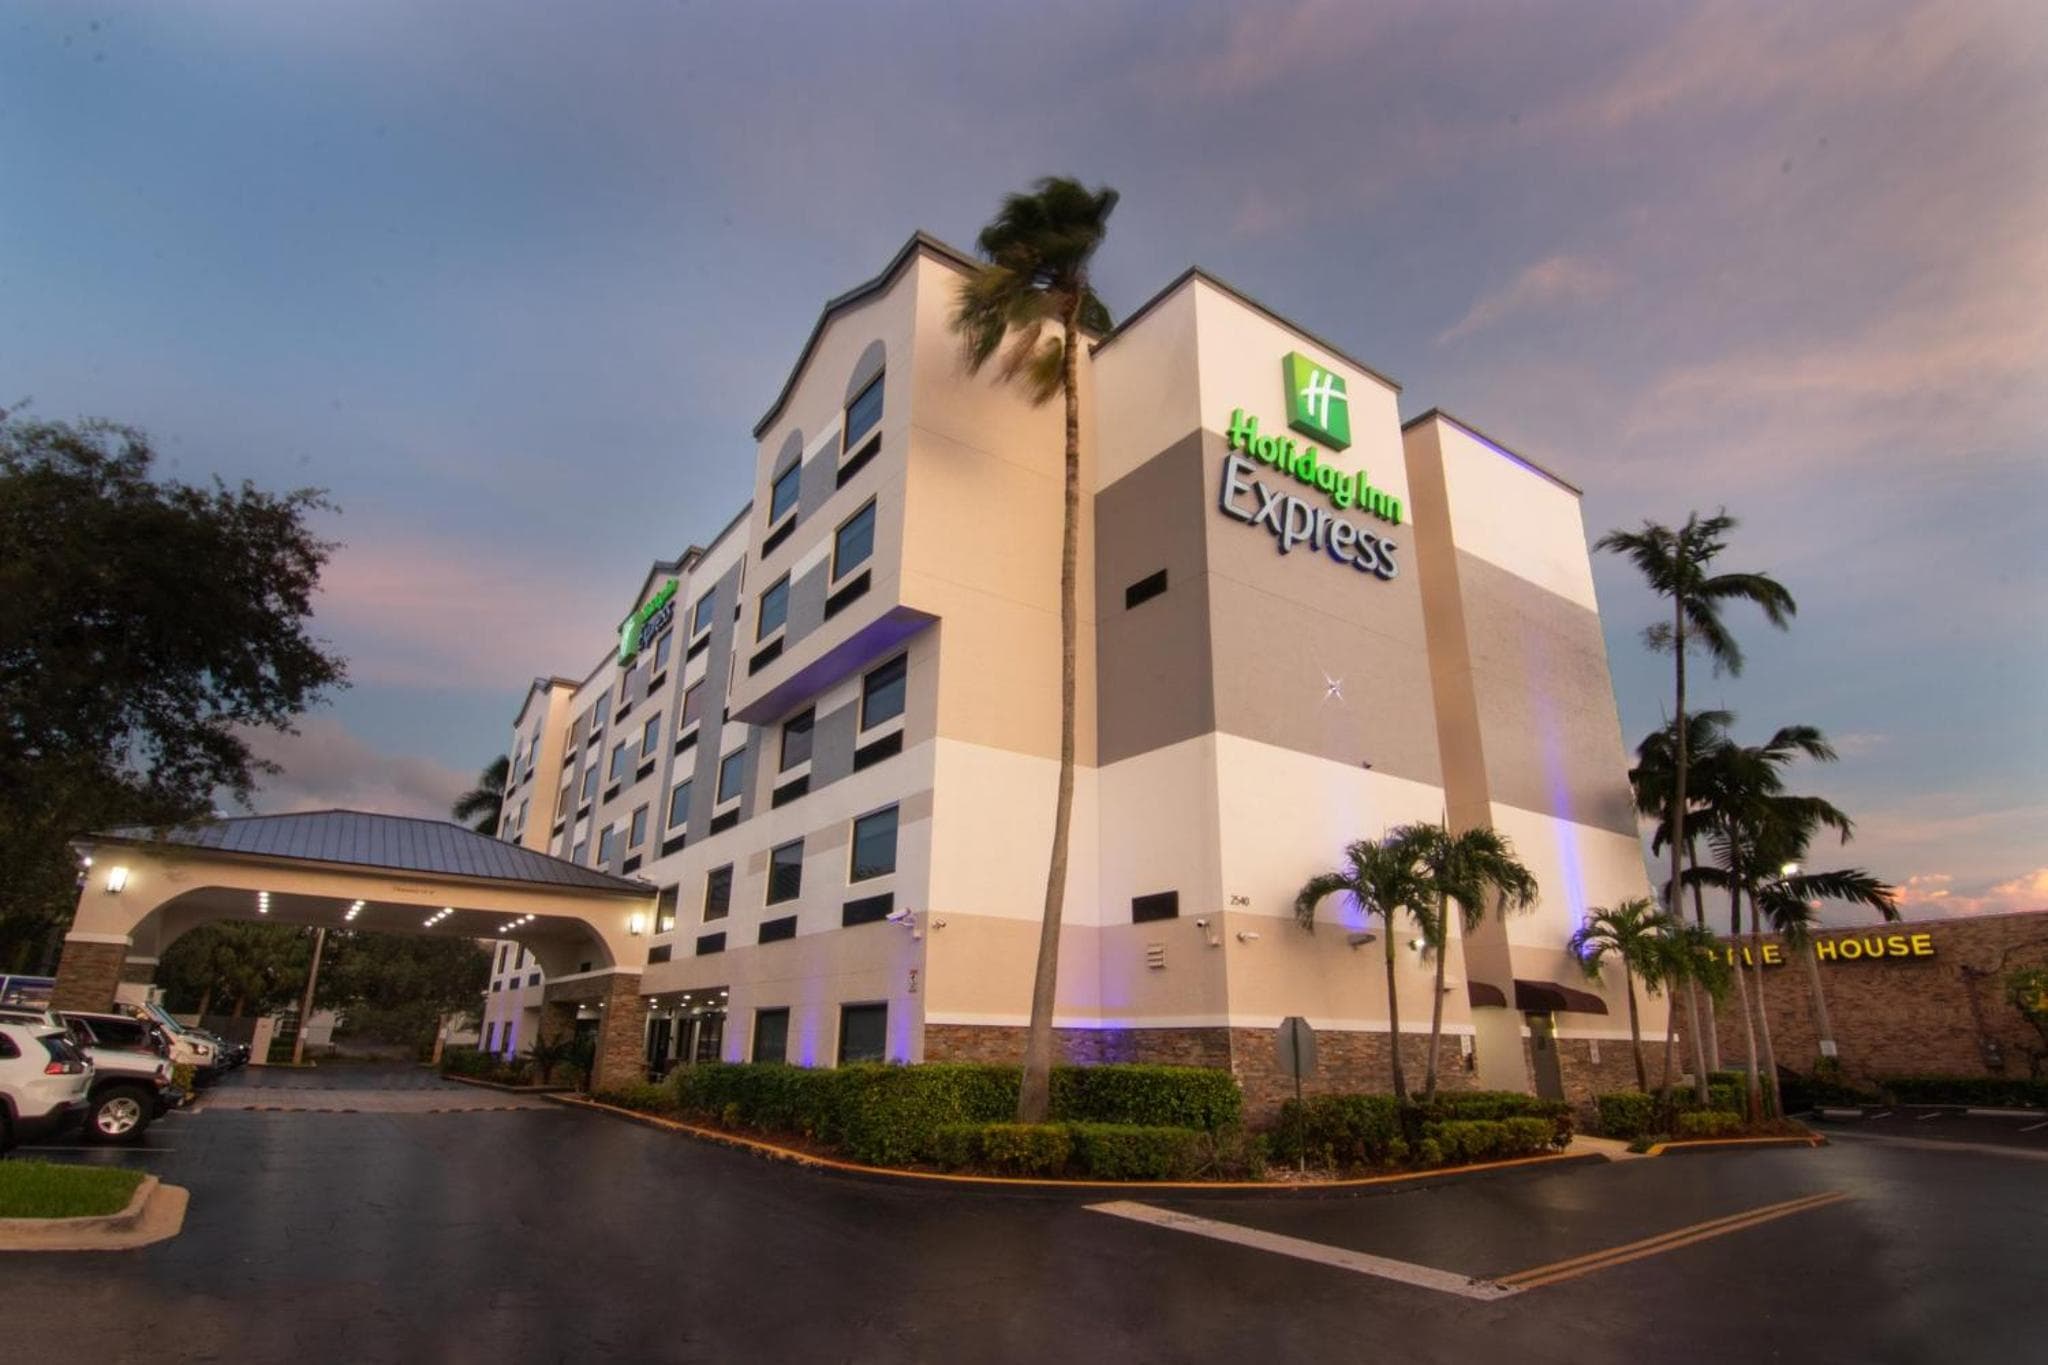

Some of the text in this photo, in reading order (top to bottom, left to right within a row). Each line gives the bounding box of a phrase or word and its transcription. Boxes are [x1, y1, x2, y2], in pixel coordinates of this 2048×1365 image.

[1219, 453, 1399, 580] Express
[1226, 408, 1403, 525] Holiday Inn
[1816, 934, 1934, 961] HOUSE
